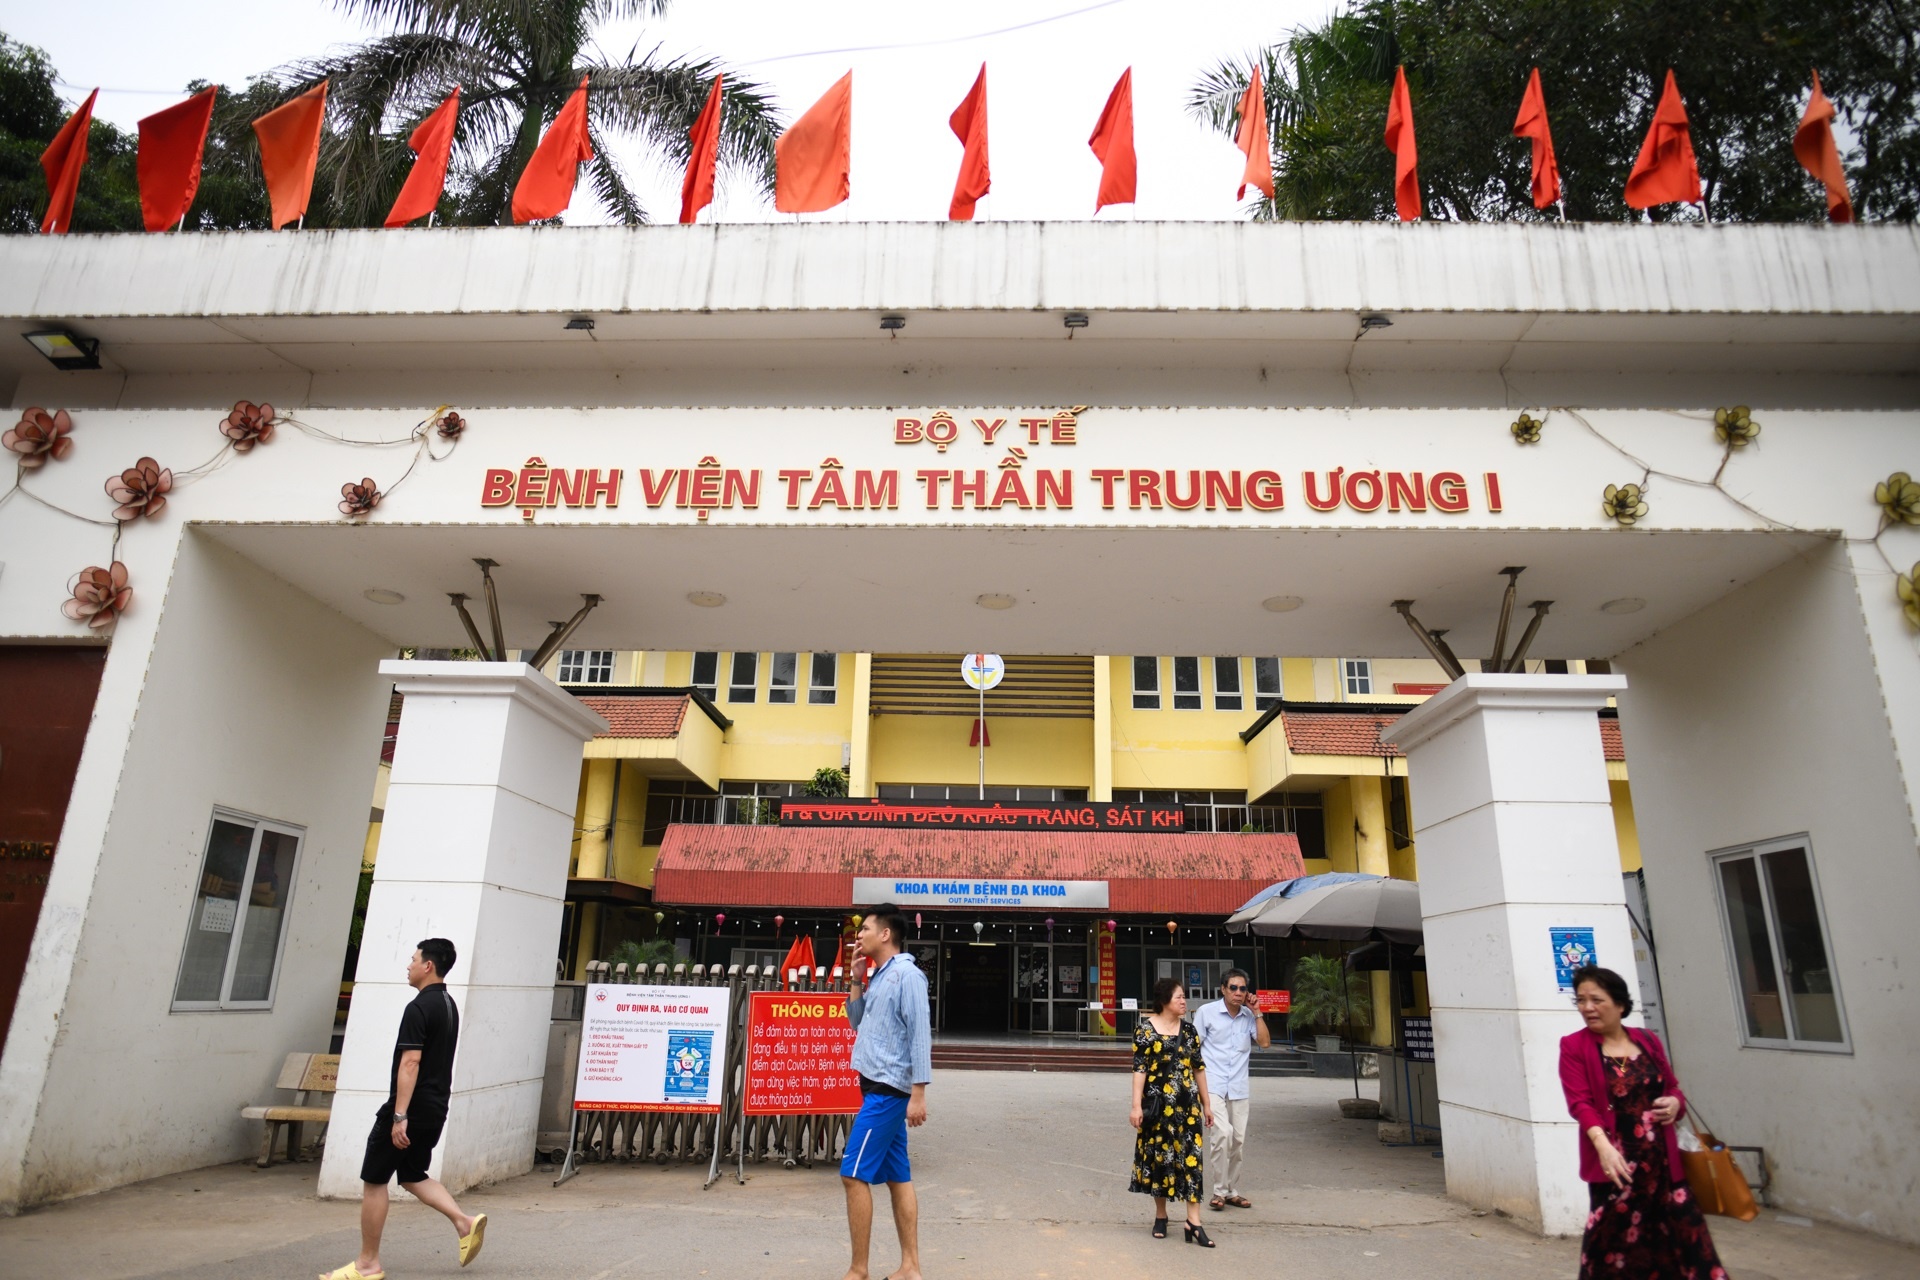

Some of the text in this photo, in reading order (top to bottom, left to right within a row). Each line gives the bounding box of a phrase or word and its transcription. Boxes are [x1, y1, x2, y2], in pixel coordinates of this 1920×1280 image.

[894, 405, 1087, 452] BỘ Y TẾ
[481, 446, 1503, 520] BỆNH VIỆN TÂM THẦN TRUNG ƯƠNG I
[1106, 805, 1146, 826] SÁT
[895, 880, 1067, 898] KHOA KHÁM BỆNH ĐA KHOA
[616, 1004, 630, 1012] QUY
[632, 1004, 648, 1014] ĐỊNH
[650, 1005, 661, 1013] RA,
[664, 1004, 677, 1013] VÀO
[690, 1006, 708, 1014] QUAN
[771, 1001, 848, 1018] THÔNG BÁ
[754, 1022, 764, 1037] Để
[766, 1024, 782, 1037] đảm
[784, 1024, 797, 1037] bảo
[800, 1028, 808, 1037] an
[811, 1026, 825, 1037] toàn
[828, 1026, 840, 1037] cho
[753, 1042, 771, 1057] đang
[800, 1042, 808, 1056] tại
[812, 1042, 828, 1056] bệnh
[830, 1042, 844, 1056] viện
[752, 1056, 850, 1073] điểm dịch Covid-19. Bệnh viện
[751, 1076, 764, 1090] tạm
[767, 1076, 784, 1090] dừng
[786, 1076, 800, 1090] việc
[802, 1076, 820, 1088] thăm,
[823, 1076, 837, 1090] gặp
[839, 1076, 851, 1086] cho
[750, 1093, 813, 1108] được thông báo lại.
